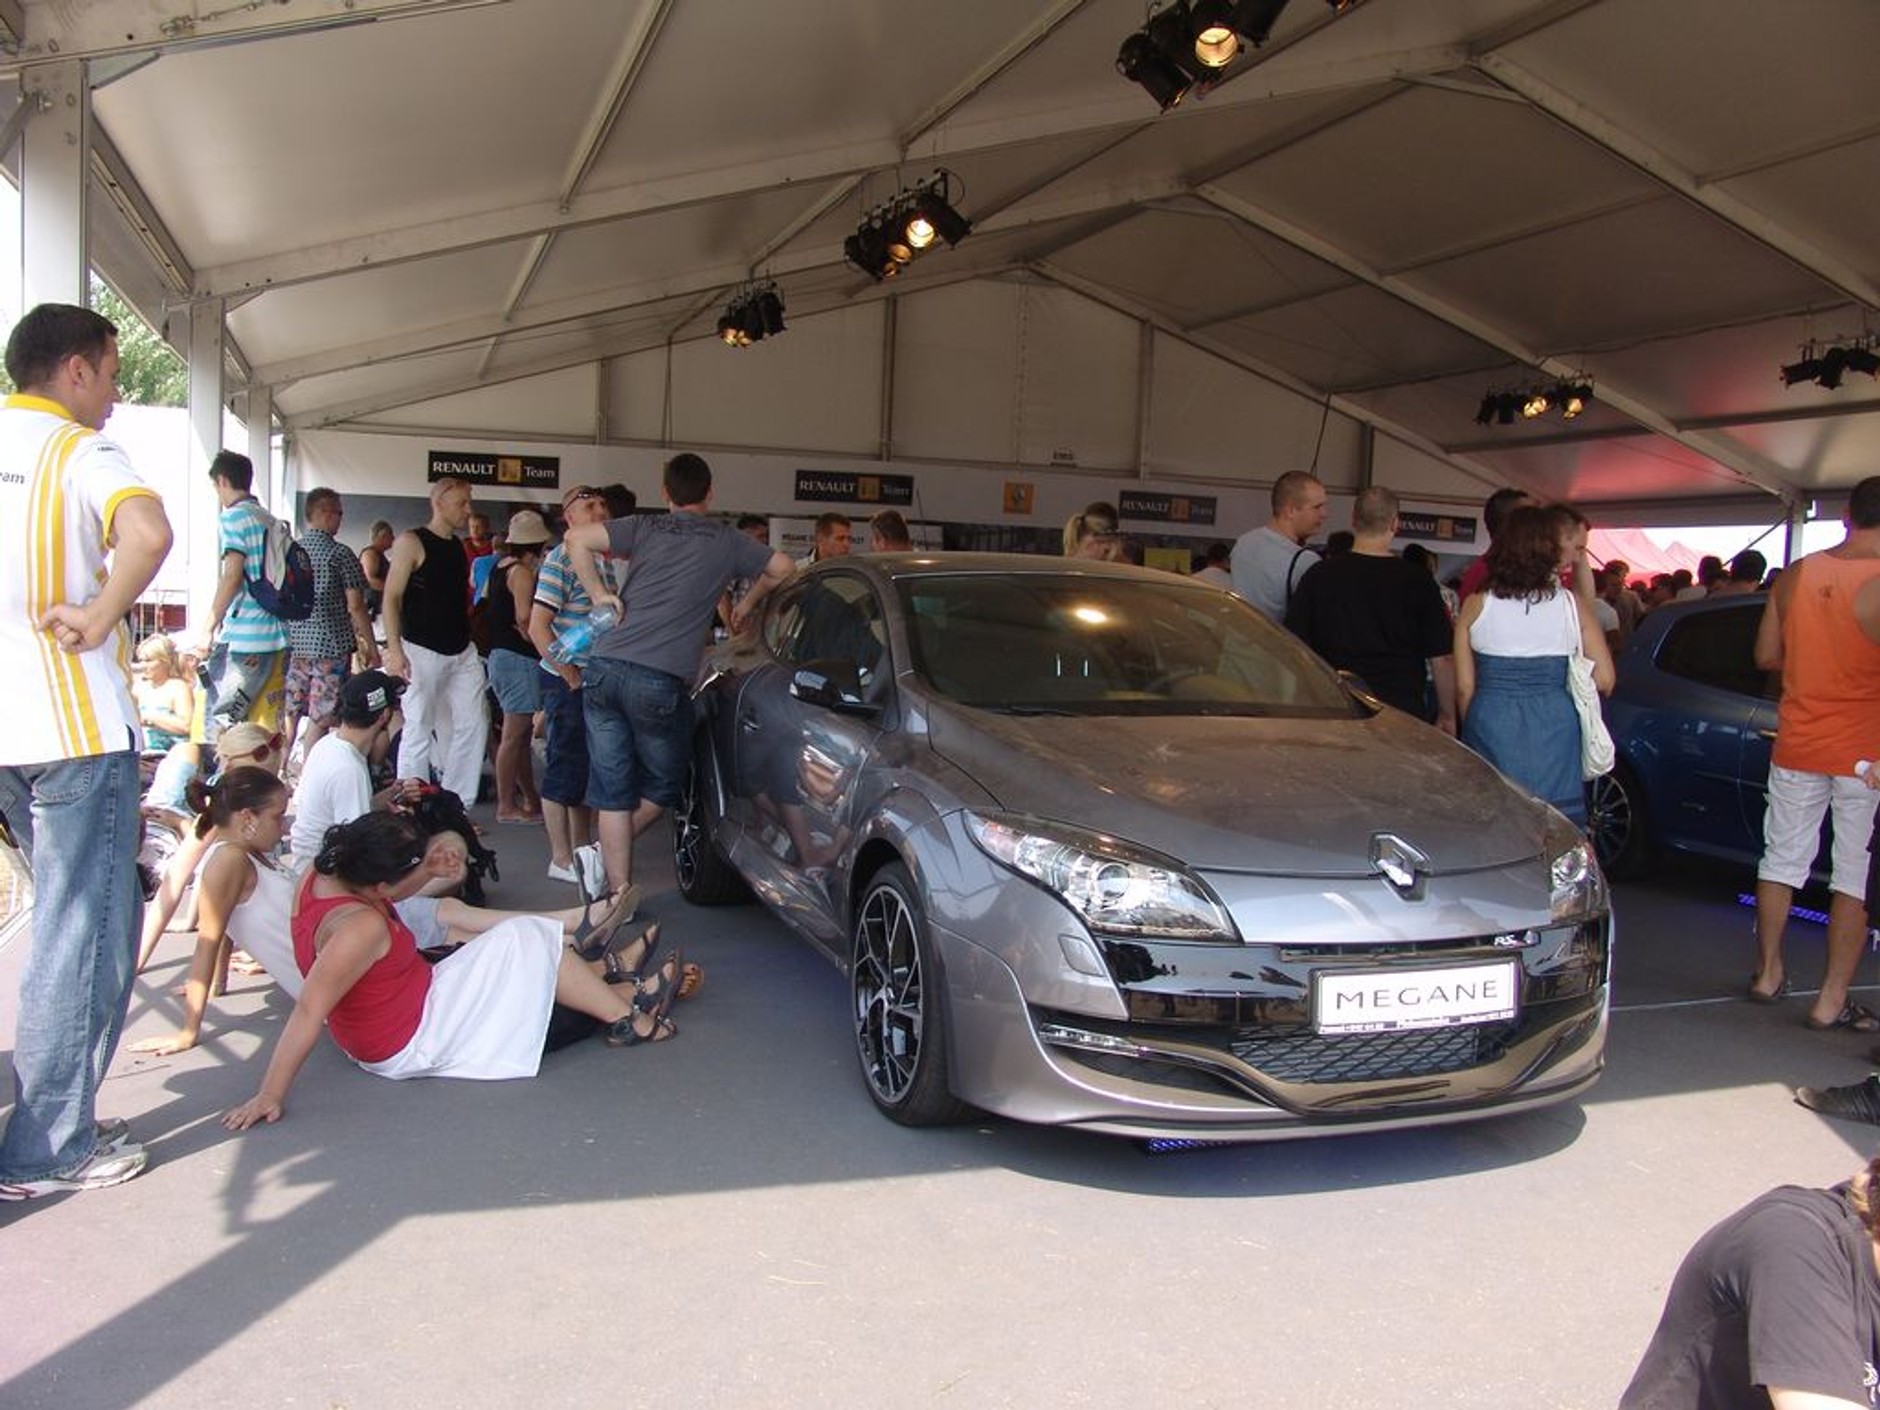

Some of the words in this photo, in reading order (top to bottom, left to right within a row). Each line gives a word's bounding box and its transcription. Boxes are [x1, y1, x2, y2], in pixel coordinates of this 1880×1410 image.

[0, 471, 25, 485] am
[433, 461, 496, 475] RENAULT
[524, 466, 556, 479] Team
[799, 480, 856, 493] RENAULT
[1336, 980, 1498, 1010] MEGANE
